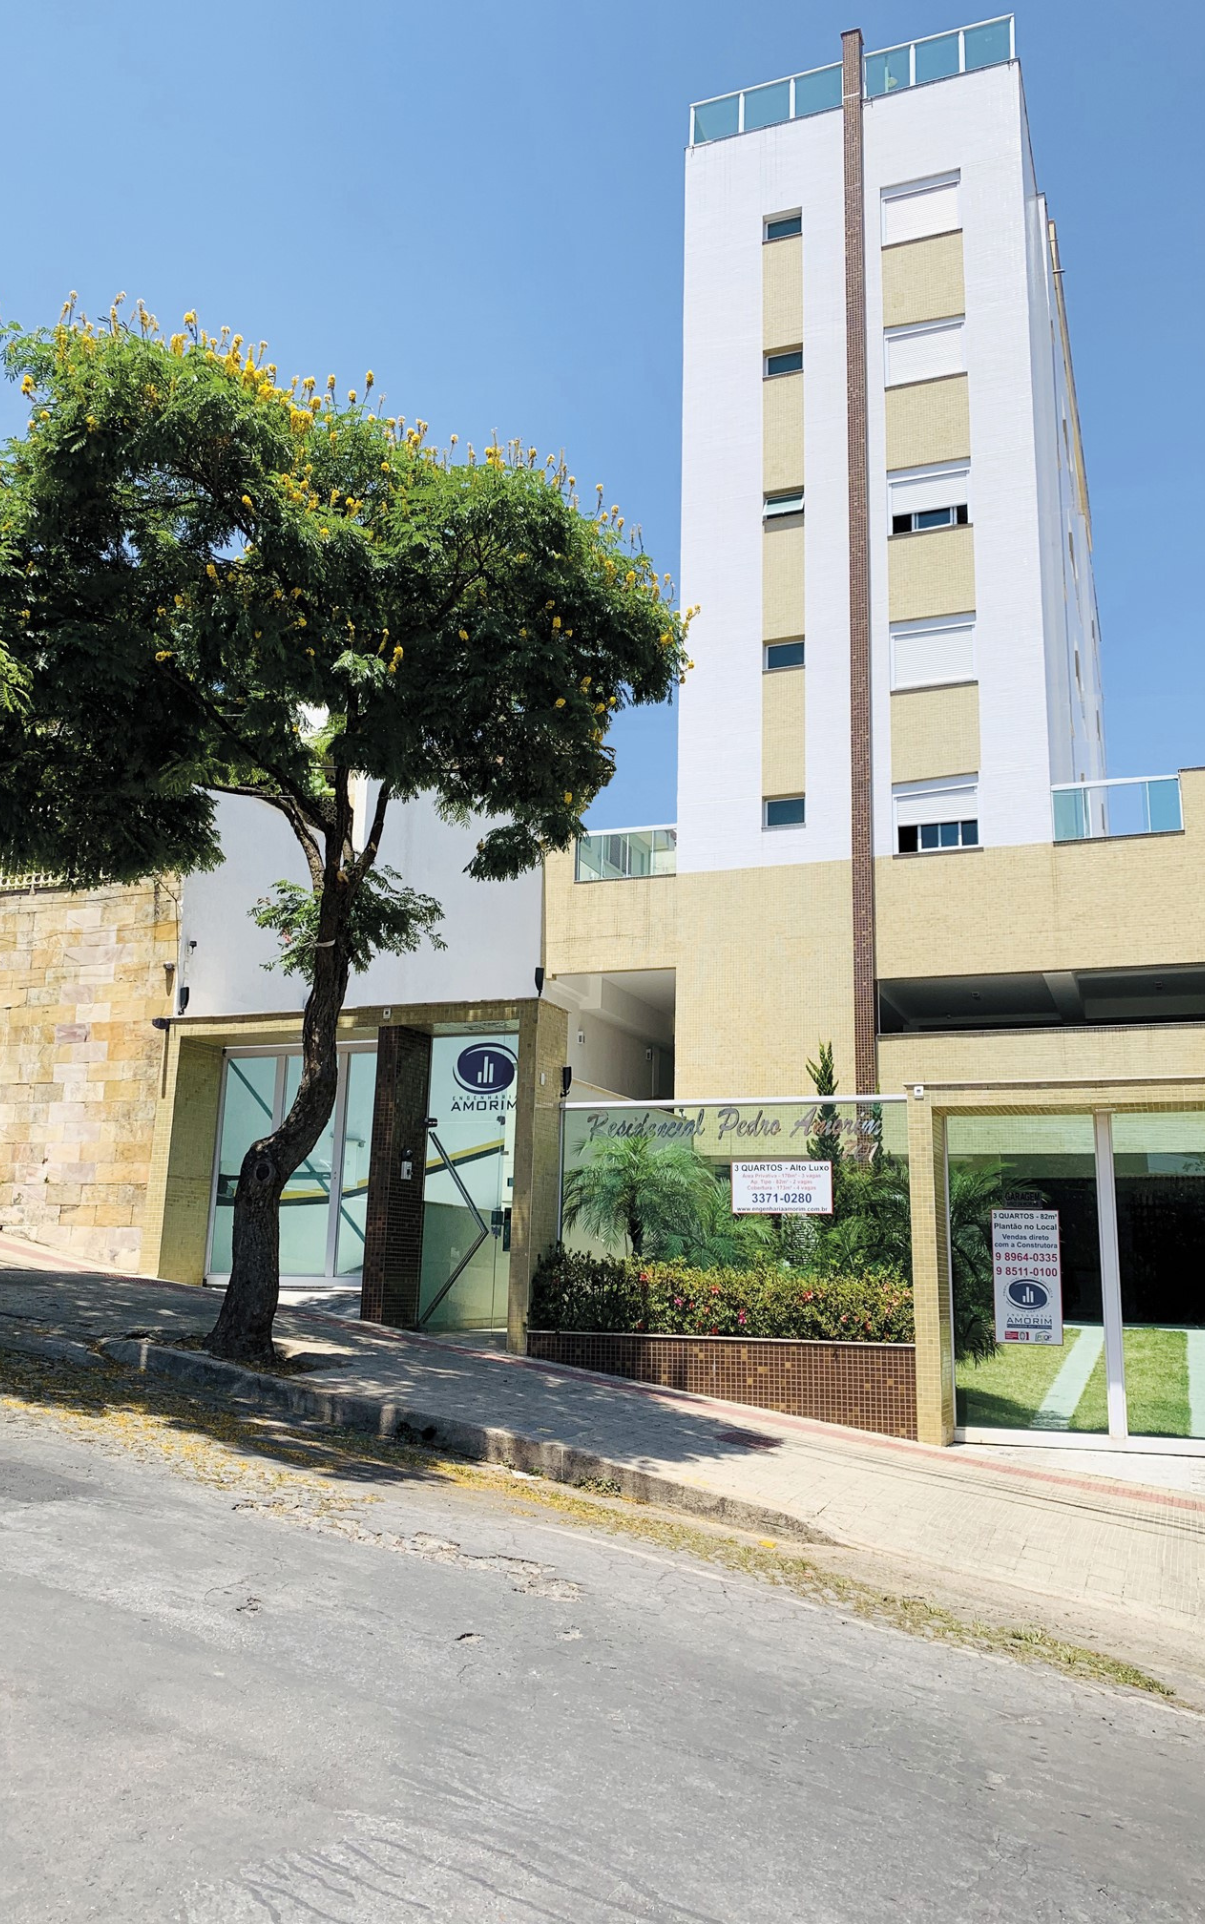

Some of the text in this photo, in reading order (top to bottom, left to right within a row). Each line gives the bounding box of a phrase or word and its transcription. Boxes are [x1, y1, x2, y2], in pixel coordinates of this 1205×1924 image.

[451, 1100, 517, 1111] AMORIM
[587, 1106, 883, 1142] Residencial Pedro Amorim
[734, 1164, 739, 1172] 3
[741, 1164, 783, 1172] QUARTOS
[789, 1164, 807, 1172] Alto
[808, 1164, 830, 1172] Luxo
[751, 1193, 812, 1203] 3371-0280
[994, 1222, 1022, 1230] Plantão
[1036, 1223, 1057, 1231] Local
[995, 1252, 1058, 1262] 9 8964-0335
[996, 1266, 1058, 1277] 9 8511-0100
[1006, 1317, 1053, 1325] AMORIM
